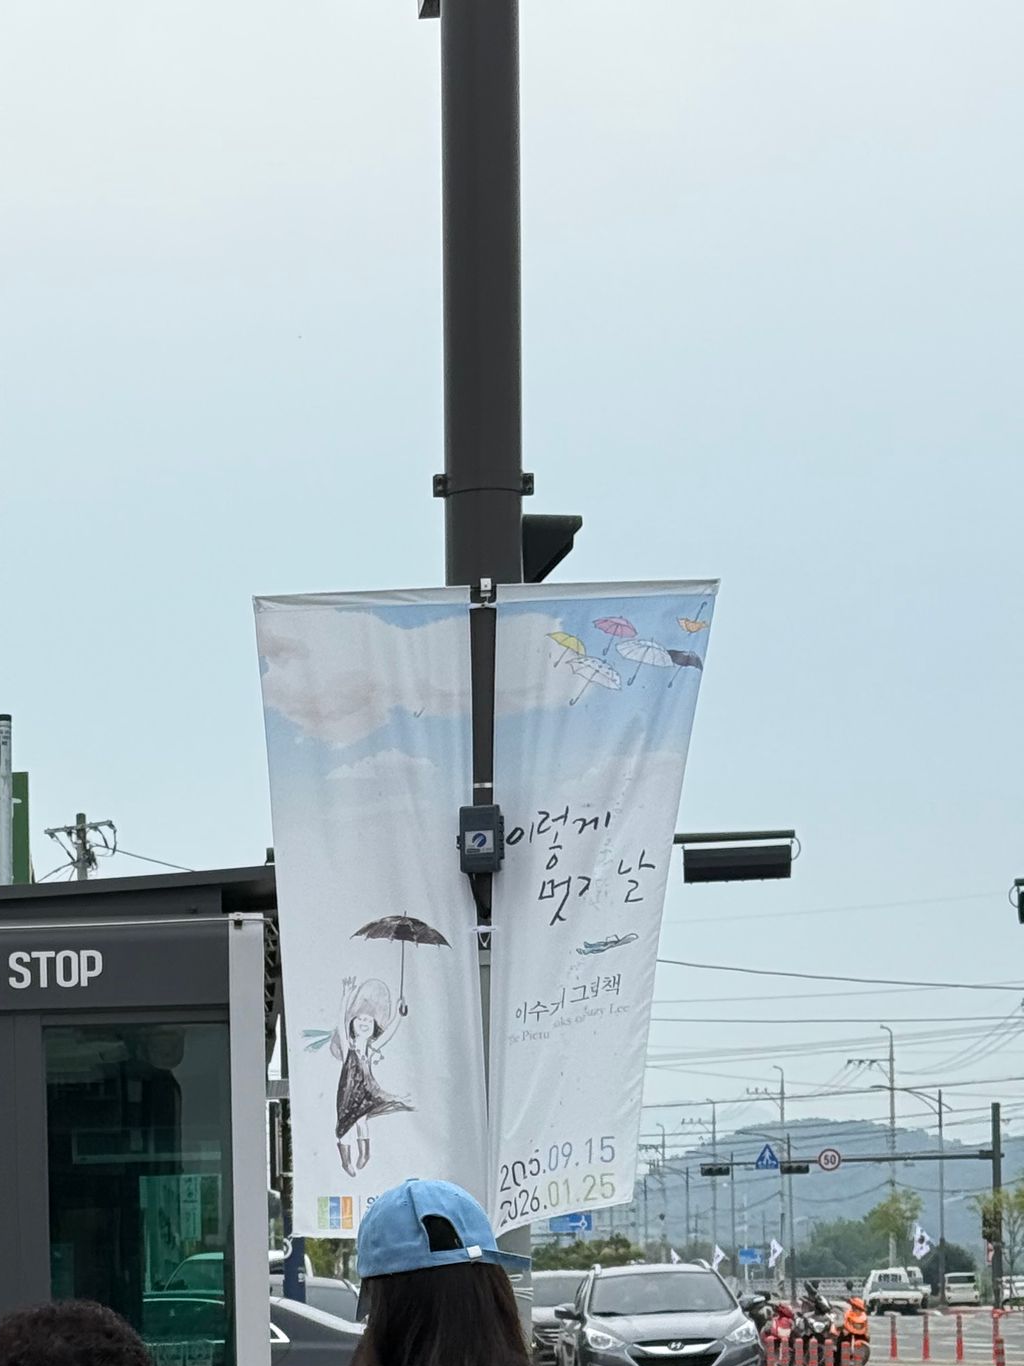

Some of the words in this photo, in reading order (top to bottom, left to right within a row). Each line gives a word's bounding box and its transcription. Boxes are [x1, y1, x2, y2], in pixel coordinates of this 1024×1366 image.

[505, 805, 611, 871] 이렇게
[617, 849, 656, 903] 날
[8, 949, 103, 989] STOP
[823, 1154, 836, 1166] 50
